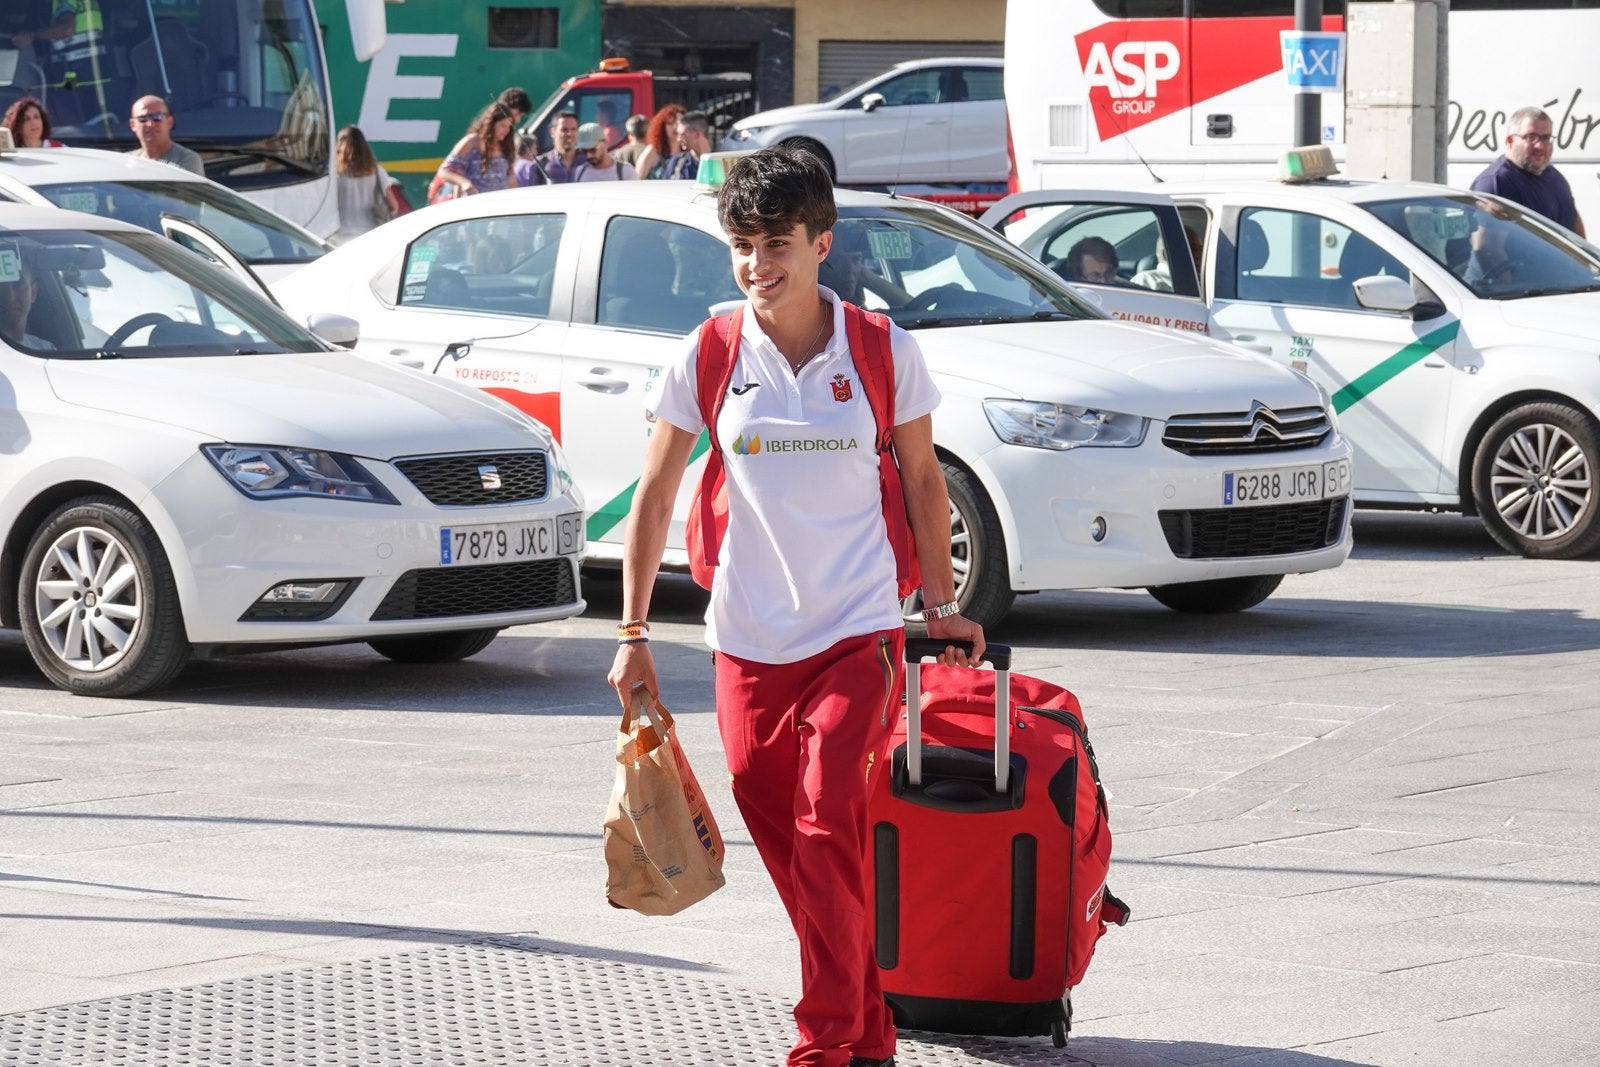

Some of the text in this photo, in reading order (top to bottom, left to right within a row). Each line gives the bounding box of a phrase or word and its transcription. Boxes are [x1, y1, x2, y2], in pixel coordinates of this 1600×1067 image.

[1083, 41, 1180, 98] ASP
[1285, 48, 1337, 75] TAXI
[1112, 100, 1156, 114] GROUP
[871, 231, 911, 257] LIBRE
[1164, 317, 1172, 327] Y
[1174, 319, 1210, 333] PRECI
[1291, 335, 1314, 347] TAXI
[1290, 347, 1313, 357] 267
[455, 367, 469, 379] YO
[472, 368, 521, 383] REPOSTO
[647, 367, 660, 378] TA
[765, 438, 858, 453] IBERDROLA
[1237, 470, 1317, 501] 6288 JCR
[455, 526, 548, 561] 7879 JXC
